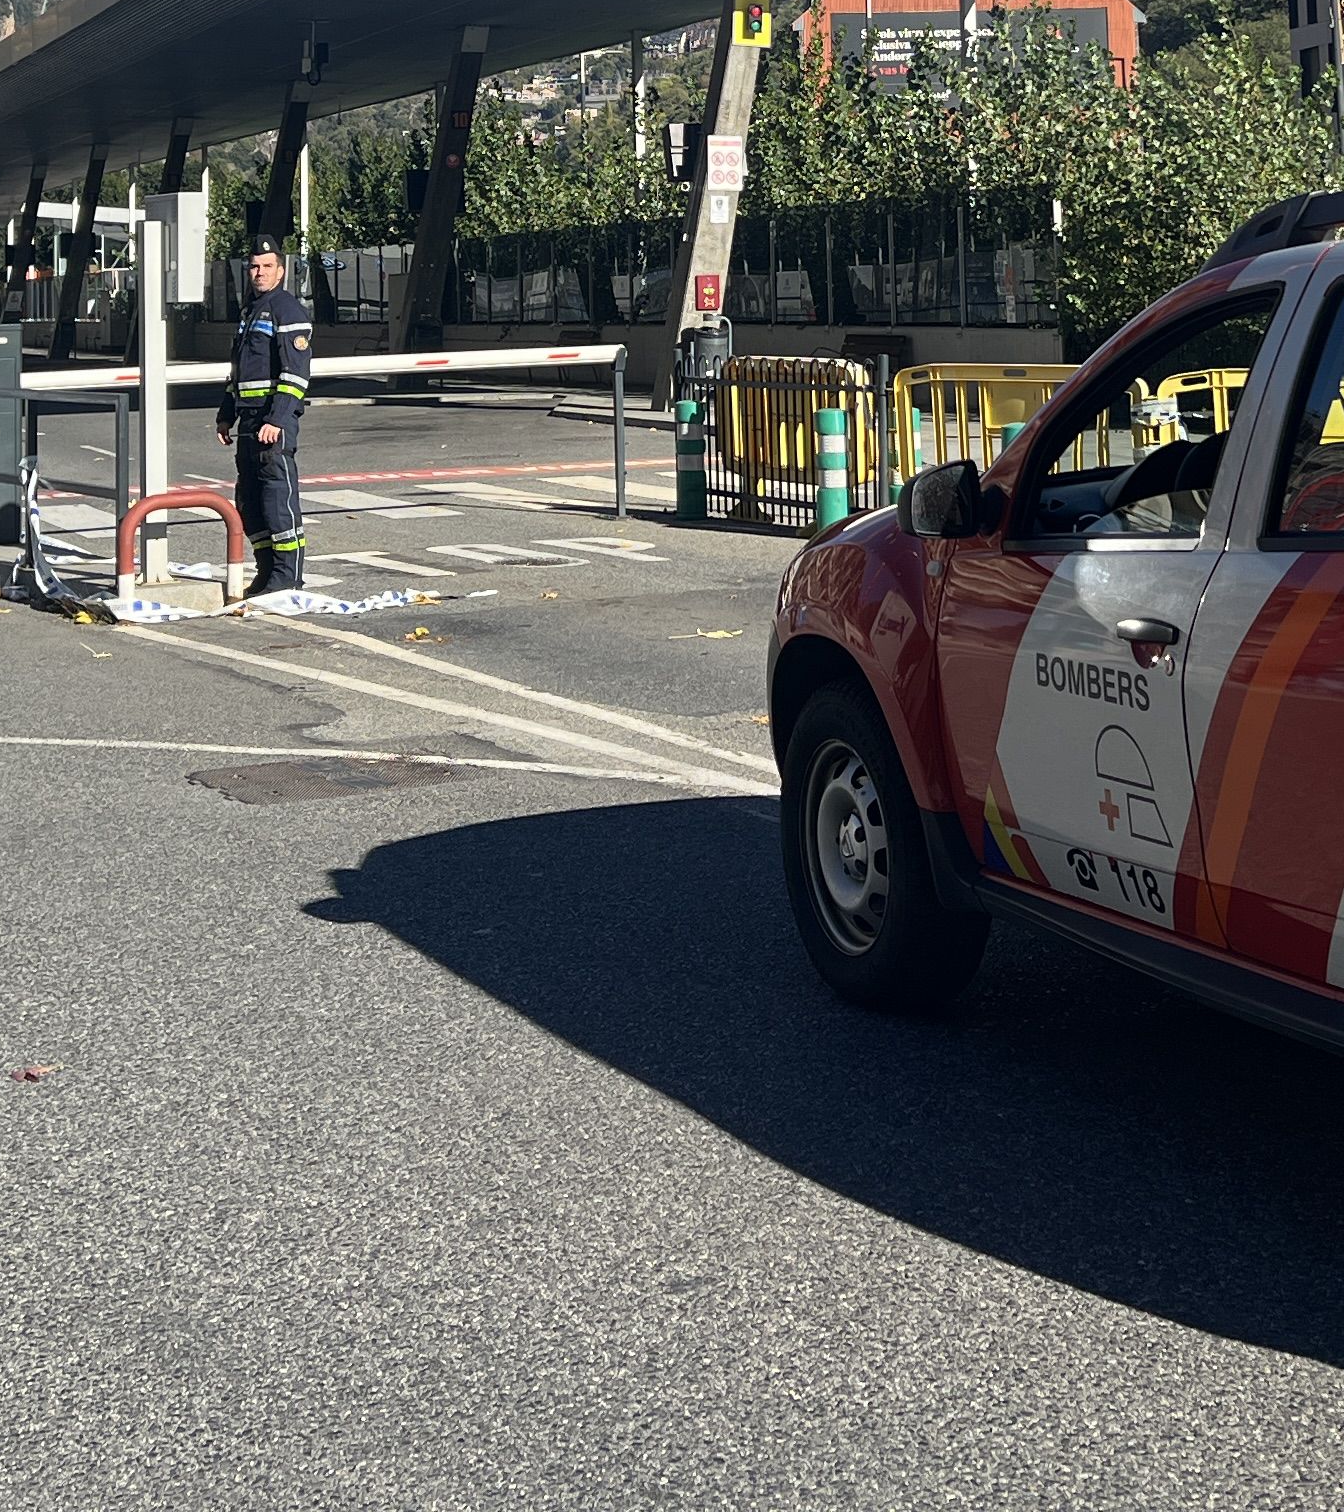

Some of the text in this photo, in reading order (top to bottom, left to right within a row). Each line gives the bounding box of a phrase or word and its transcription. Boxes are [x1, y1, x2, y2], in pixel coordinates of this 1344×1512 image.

[453, 112, 469, 128] 10
[1036, 652, 1151, 712] BOMBERS
[1111, 859, 1166, 915] 118
